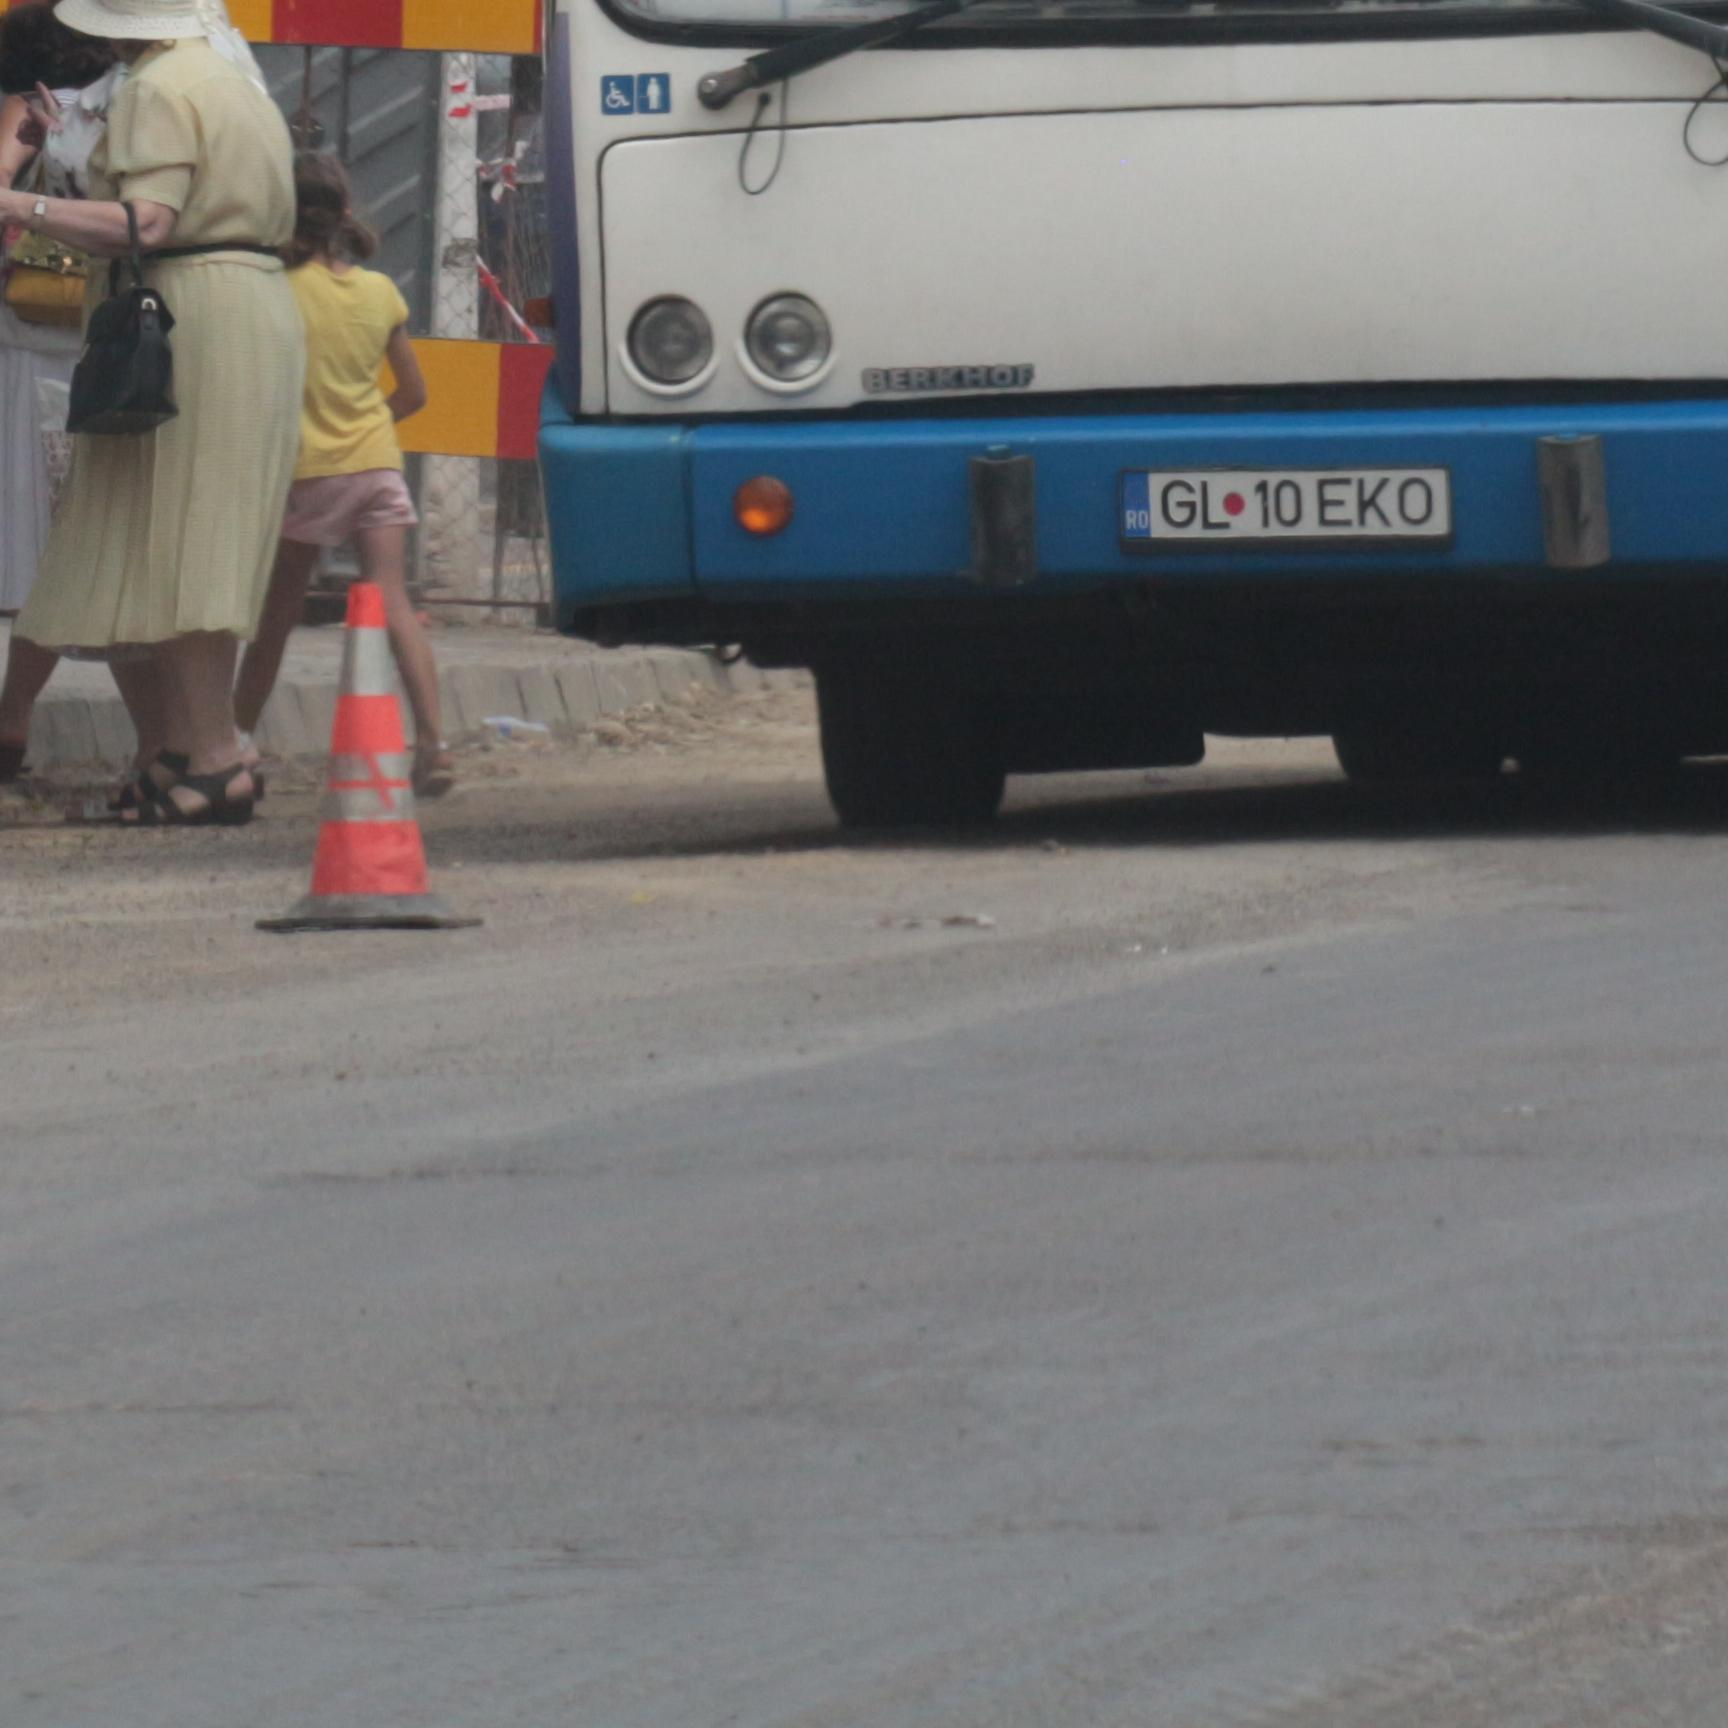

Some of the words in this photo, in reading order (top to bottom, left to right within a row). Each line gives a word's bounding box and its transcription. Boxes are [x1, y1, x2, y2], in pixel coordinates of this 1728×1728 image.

[861, 363, 1035, 394] BERKHOF
[1160, 478, 1231, 530] GL
[1254, 478, 1303, 529] 10
[1317, 476, 1434, 528] EKO
[1125, 509, 1149, 530] RO
